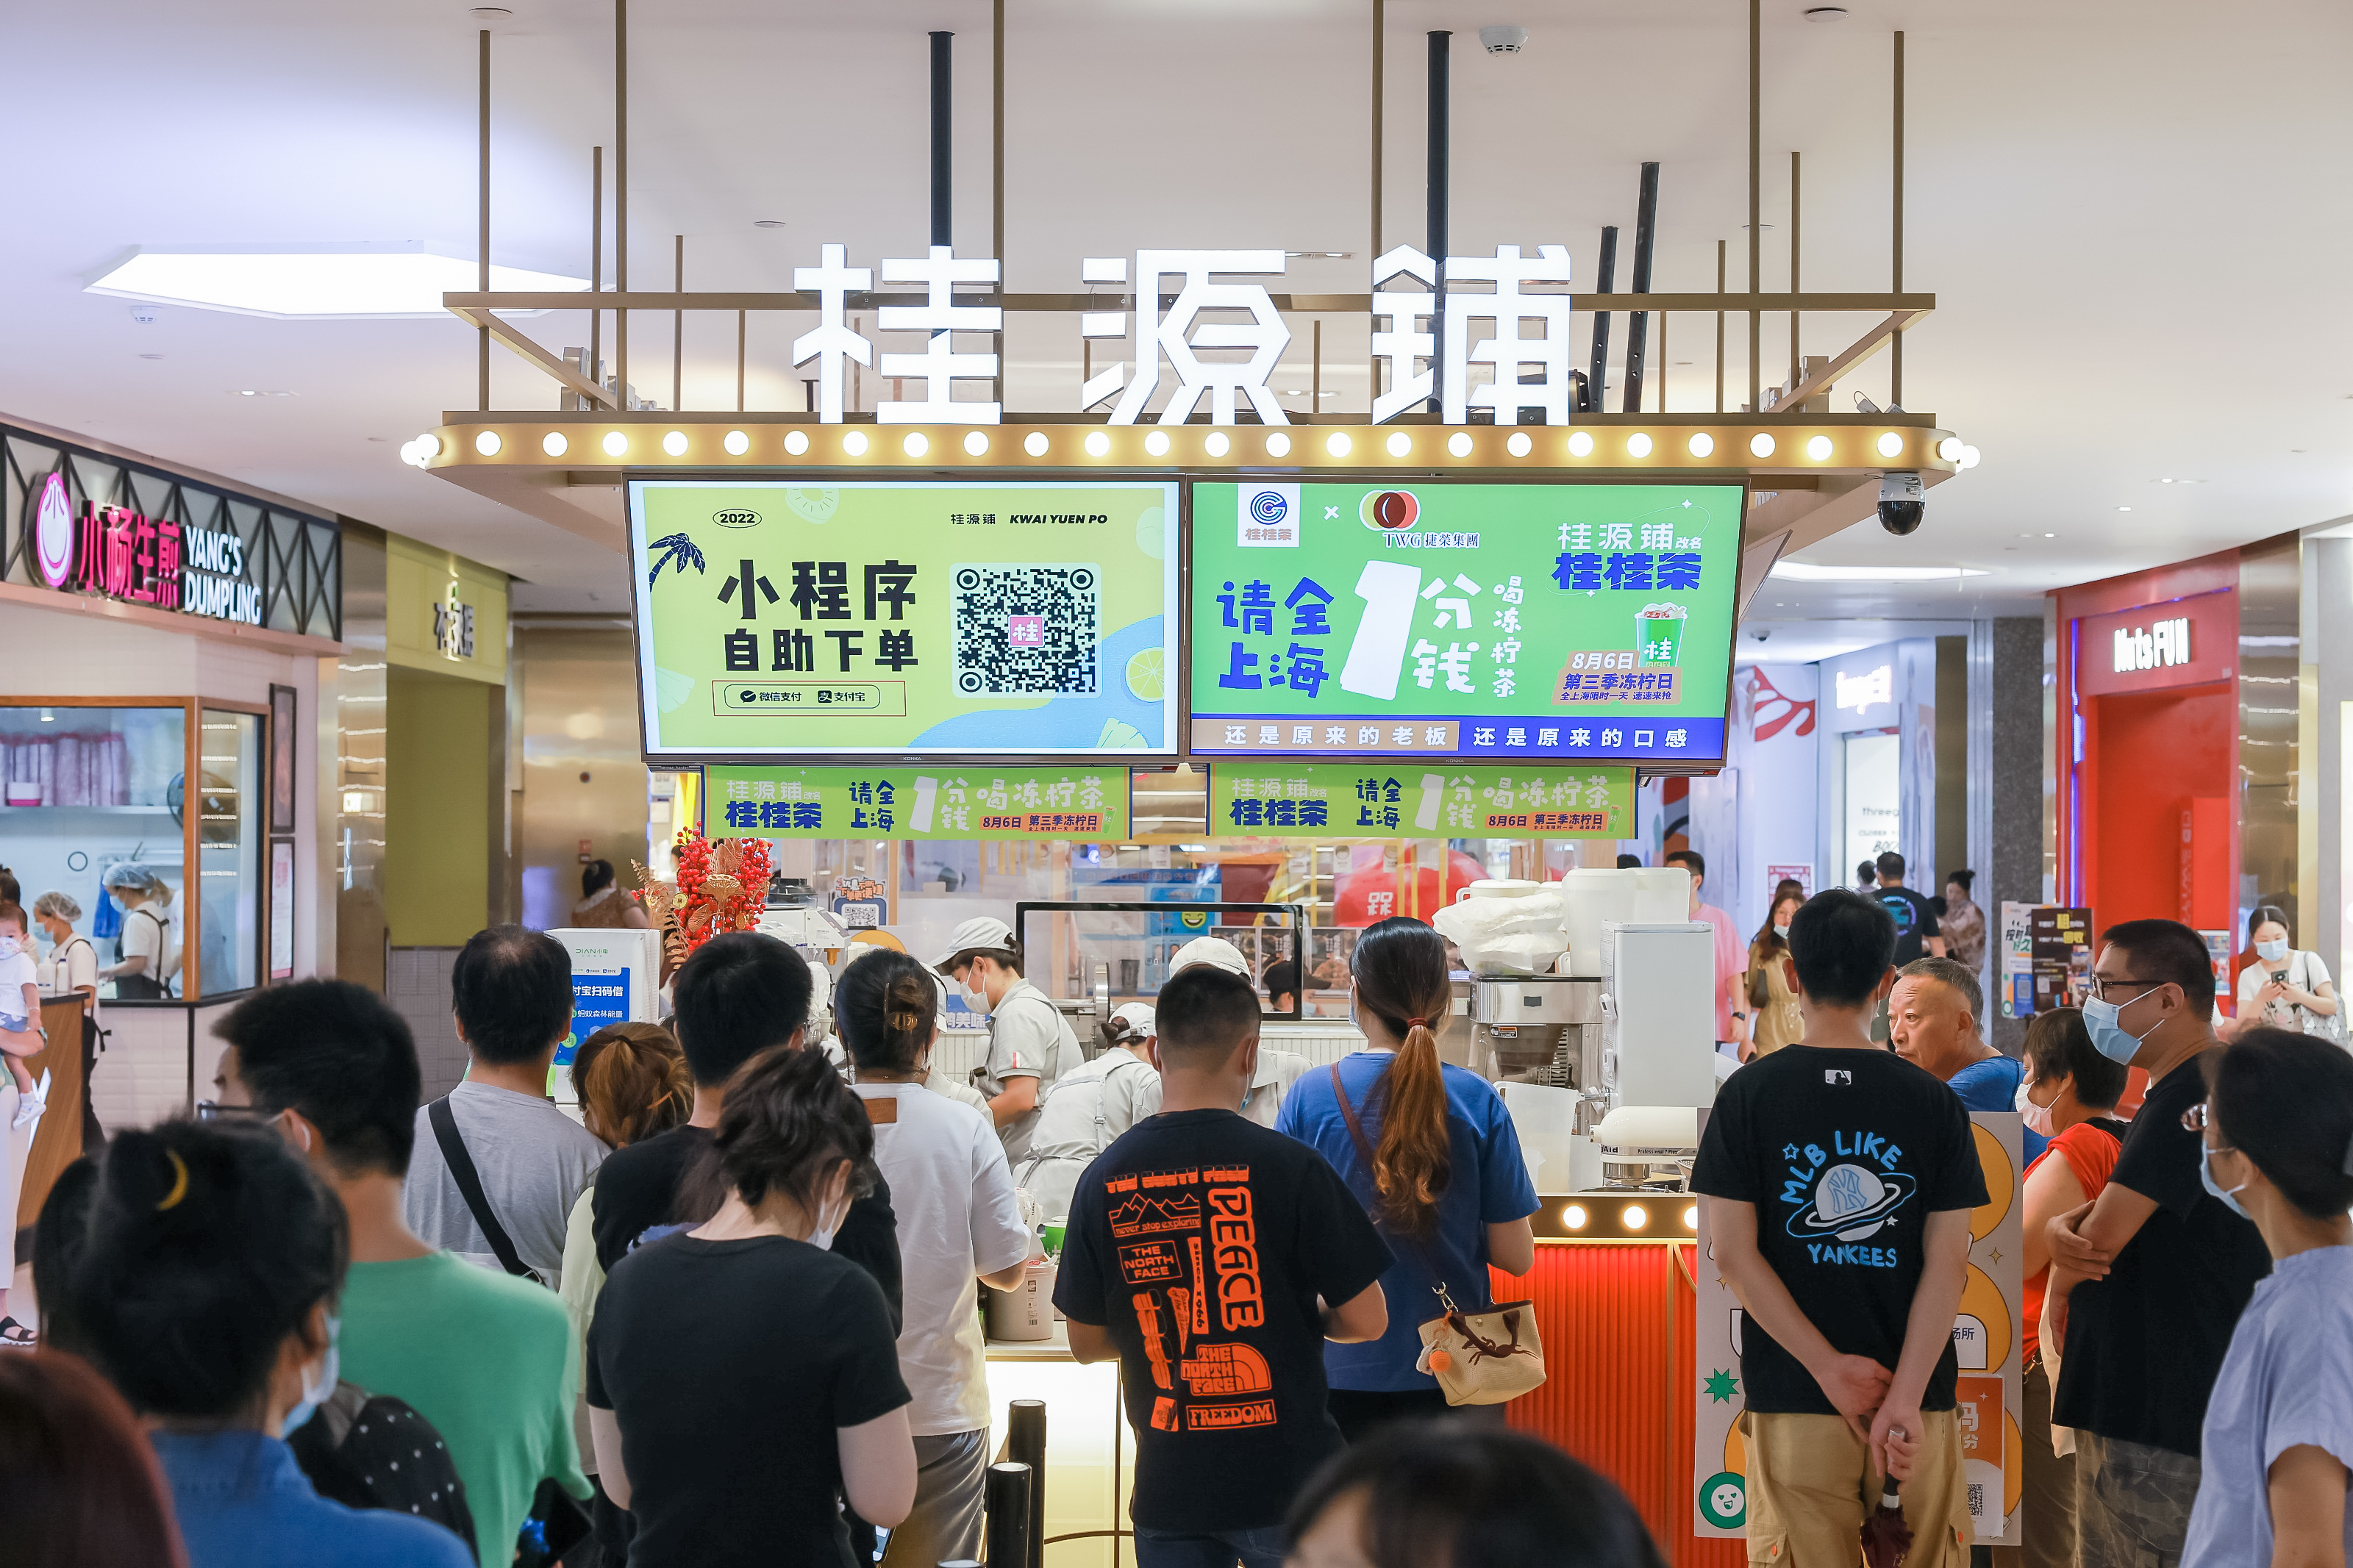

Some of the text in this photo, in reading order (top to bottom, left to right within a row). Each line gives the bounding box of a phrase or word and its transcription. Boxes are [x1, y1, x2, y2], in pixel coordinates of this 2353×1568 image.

[720, 513, 756, 523] 2022
[1010, 515, 1047, 524] KWAI
[1050, 515, 1085, 524] YUEN
[1088, 515, 1108, 524] PO
[185, 524, 243, 577] YANG'S
[1383, 532, 1421, 548] TWG
[1675, 537, 1702, 550] 改名
[184, 570, 262, 626] DUMPLING
[717, 559, 917, 620] 小程序
[1216, 576, 1335, 636] 请全
[1490, 575, 1524, 698] 喝冻柠茶
[1643, 636, 1672, 660] 桂
[724, 628, 918, 672] 自助下单
[1571, 651, 1635, 670] 8月6日
[1218, 641, 1329, 699] 上海
[1563, 673, 1674, 690] 第三季冻柠日
[759, 691, 865, 702] 微信支付 支付宝
[1560, 691, 1672, 701] 全上海限时一天 速速来抢
[1224, 723, 1447, 747] 还是原来的老板
[1472, 726, 1688, 749] 还是原来的口感
[803, 791, 821, 801] 改名
[849, 779, 896, 805] 请全
[976, 776, 1104, 810] 喝冻柠茶
[1310, 788, 1327, 798] 改名
[1355, 776, 1402, 803] 请全
[1483, 775, 1610, 809] 喝冻柠茶
[850, 807, 895, 832] 上海
[982, 815, 1098, 828] 8月6日 第三季冻柠日
[1356, 804, 1401, 830] 上海
[1488, 813, 1603, 827] 8月6日 第三季冻柠日
[572, 985, 624, 997] 付宝扫码借
[577, 1009, 623, 1018] 蚂蚁森林能量
[1780, 1131, 1902, 1203] MLB LIKE
[1115, 1217, 1201, 1236] never stop exploring
[1124, 1255, 1174, 1269] NORTH
[1132, 1245, 1161, 1257] THE
[1212, 1190, 1260, 1328] PEACE
[1807, 1243, 1897, 1267] YANKEES
[1134, 1266, 1170, 1278] FACE
[1199, 1346, 1232, 1362] THE
[1189, 1403, 1273, 1426] FREEDOM
